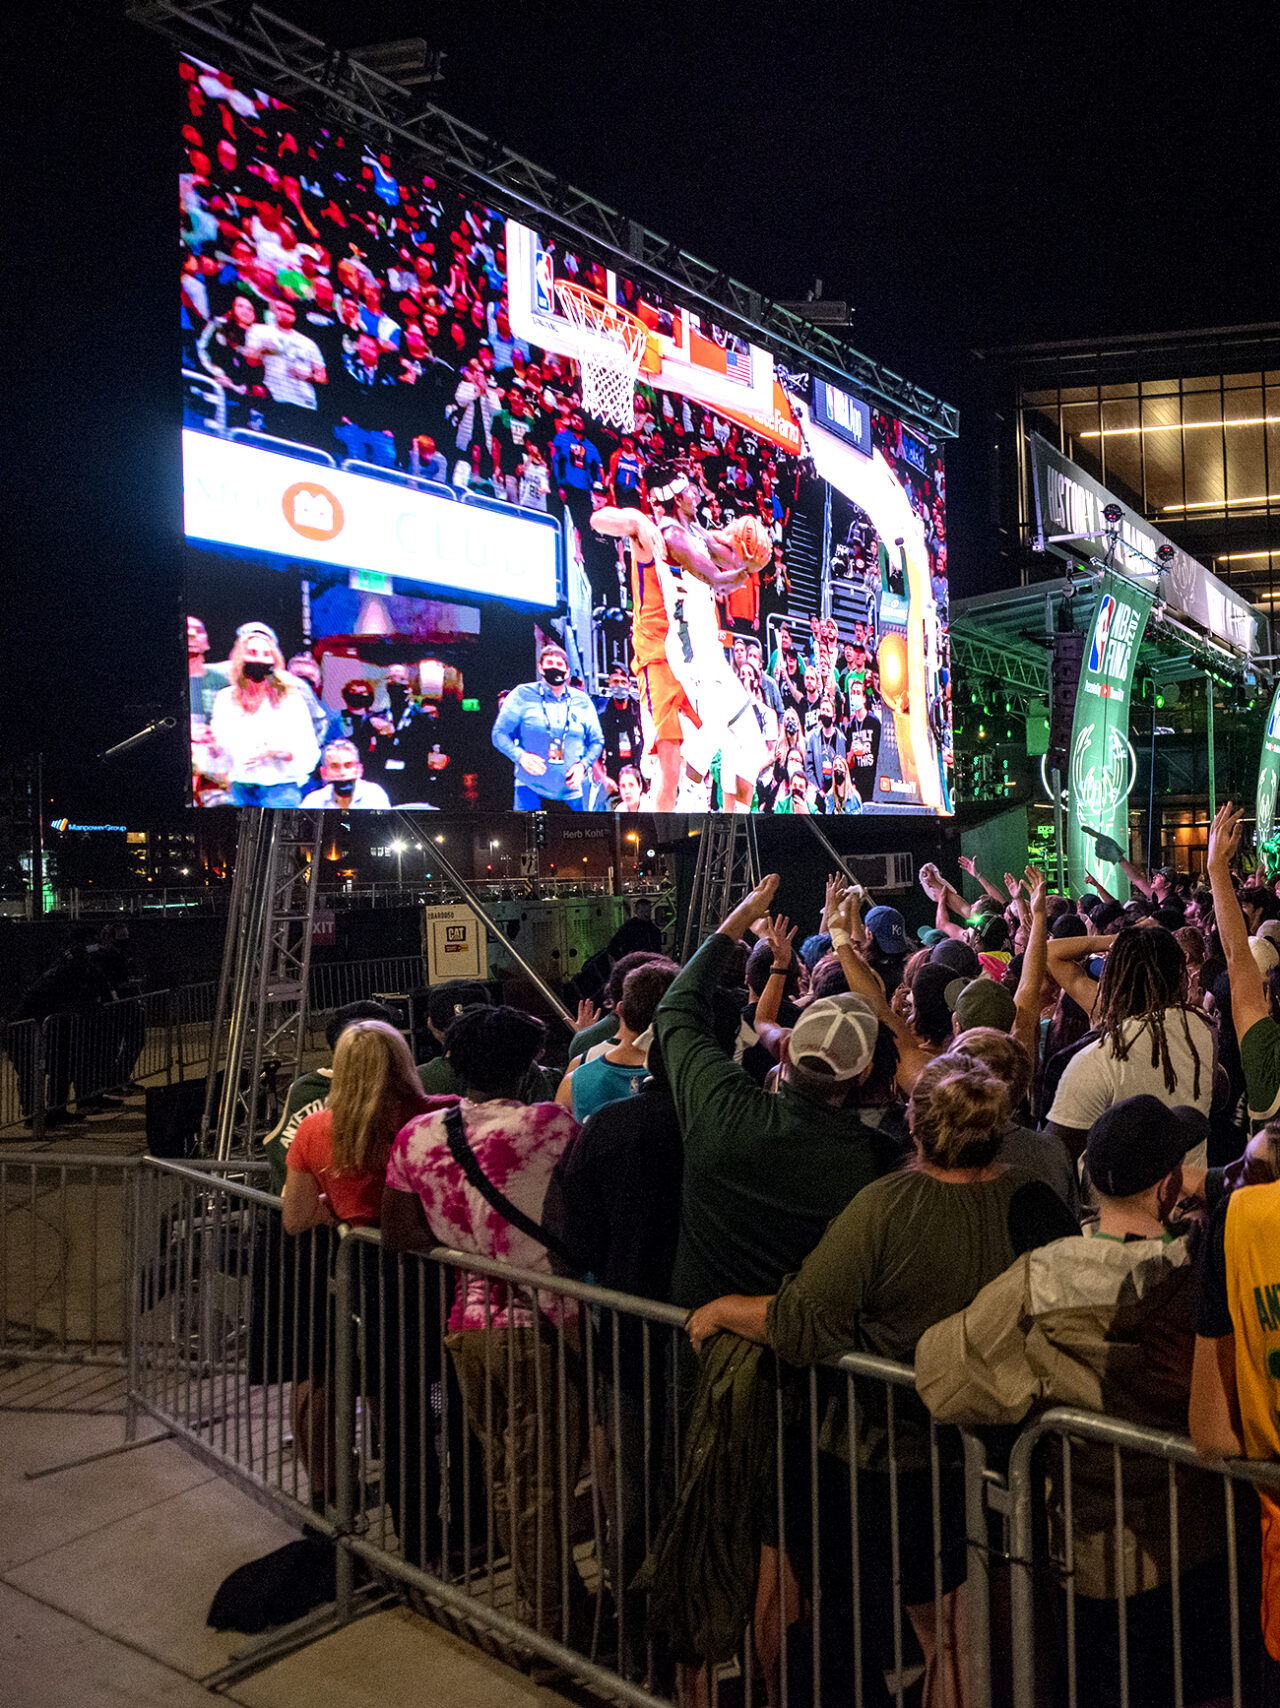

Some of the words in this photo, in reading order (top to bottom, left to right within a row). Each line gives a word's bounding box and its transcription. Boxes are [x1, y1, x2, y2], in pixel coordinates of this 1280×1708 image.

[1047, 464, 1096, 544] HISTORY
[68, 823, 127, 832] ManpowerGroup
[312, 921, 334, 934] XIT
[892, 924, 902, 936] KC
[448, 928, 464, 940] CAT
